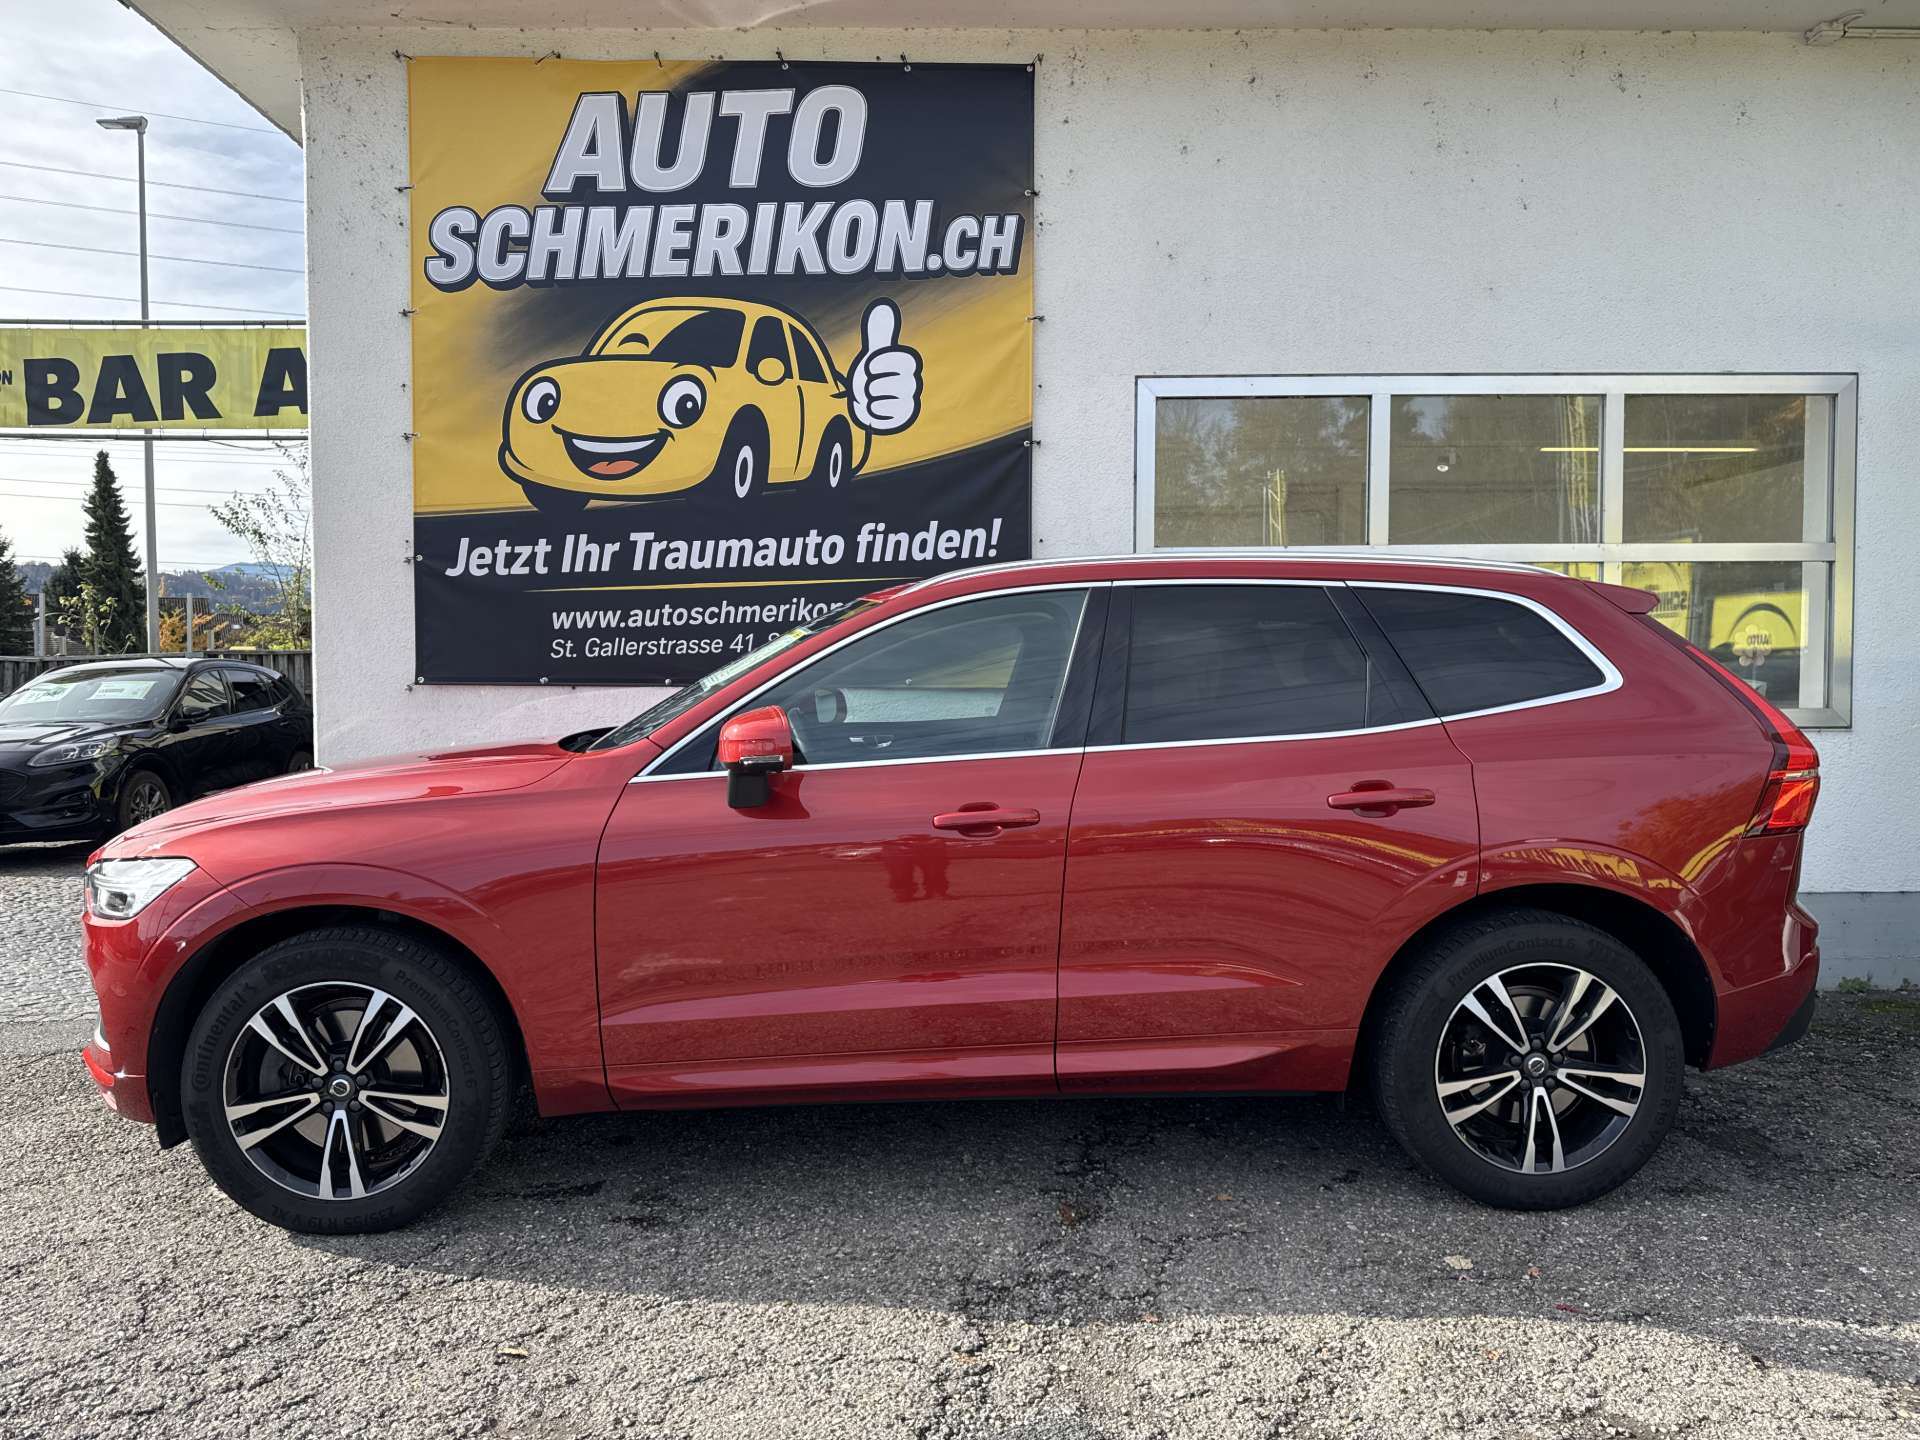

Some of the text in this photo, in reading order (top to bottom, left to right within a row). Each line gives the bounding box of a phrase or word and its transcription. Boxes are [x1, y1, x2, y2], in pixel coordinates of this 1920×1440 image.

[545, 84, 867, 197] AUTO
[425, 199, 1021, 287] SCHMERIKON.CH
[23, 352, 223, 426] BAR
[445, 517, 1002, 577] Jetzt Ihr Traumauto finden!
[550, 638, 577, 658] St.
[584, 635, 723, 657] Gallerstrasse
[191, 991, 248, 1092] Continental
